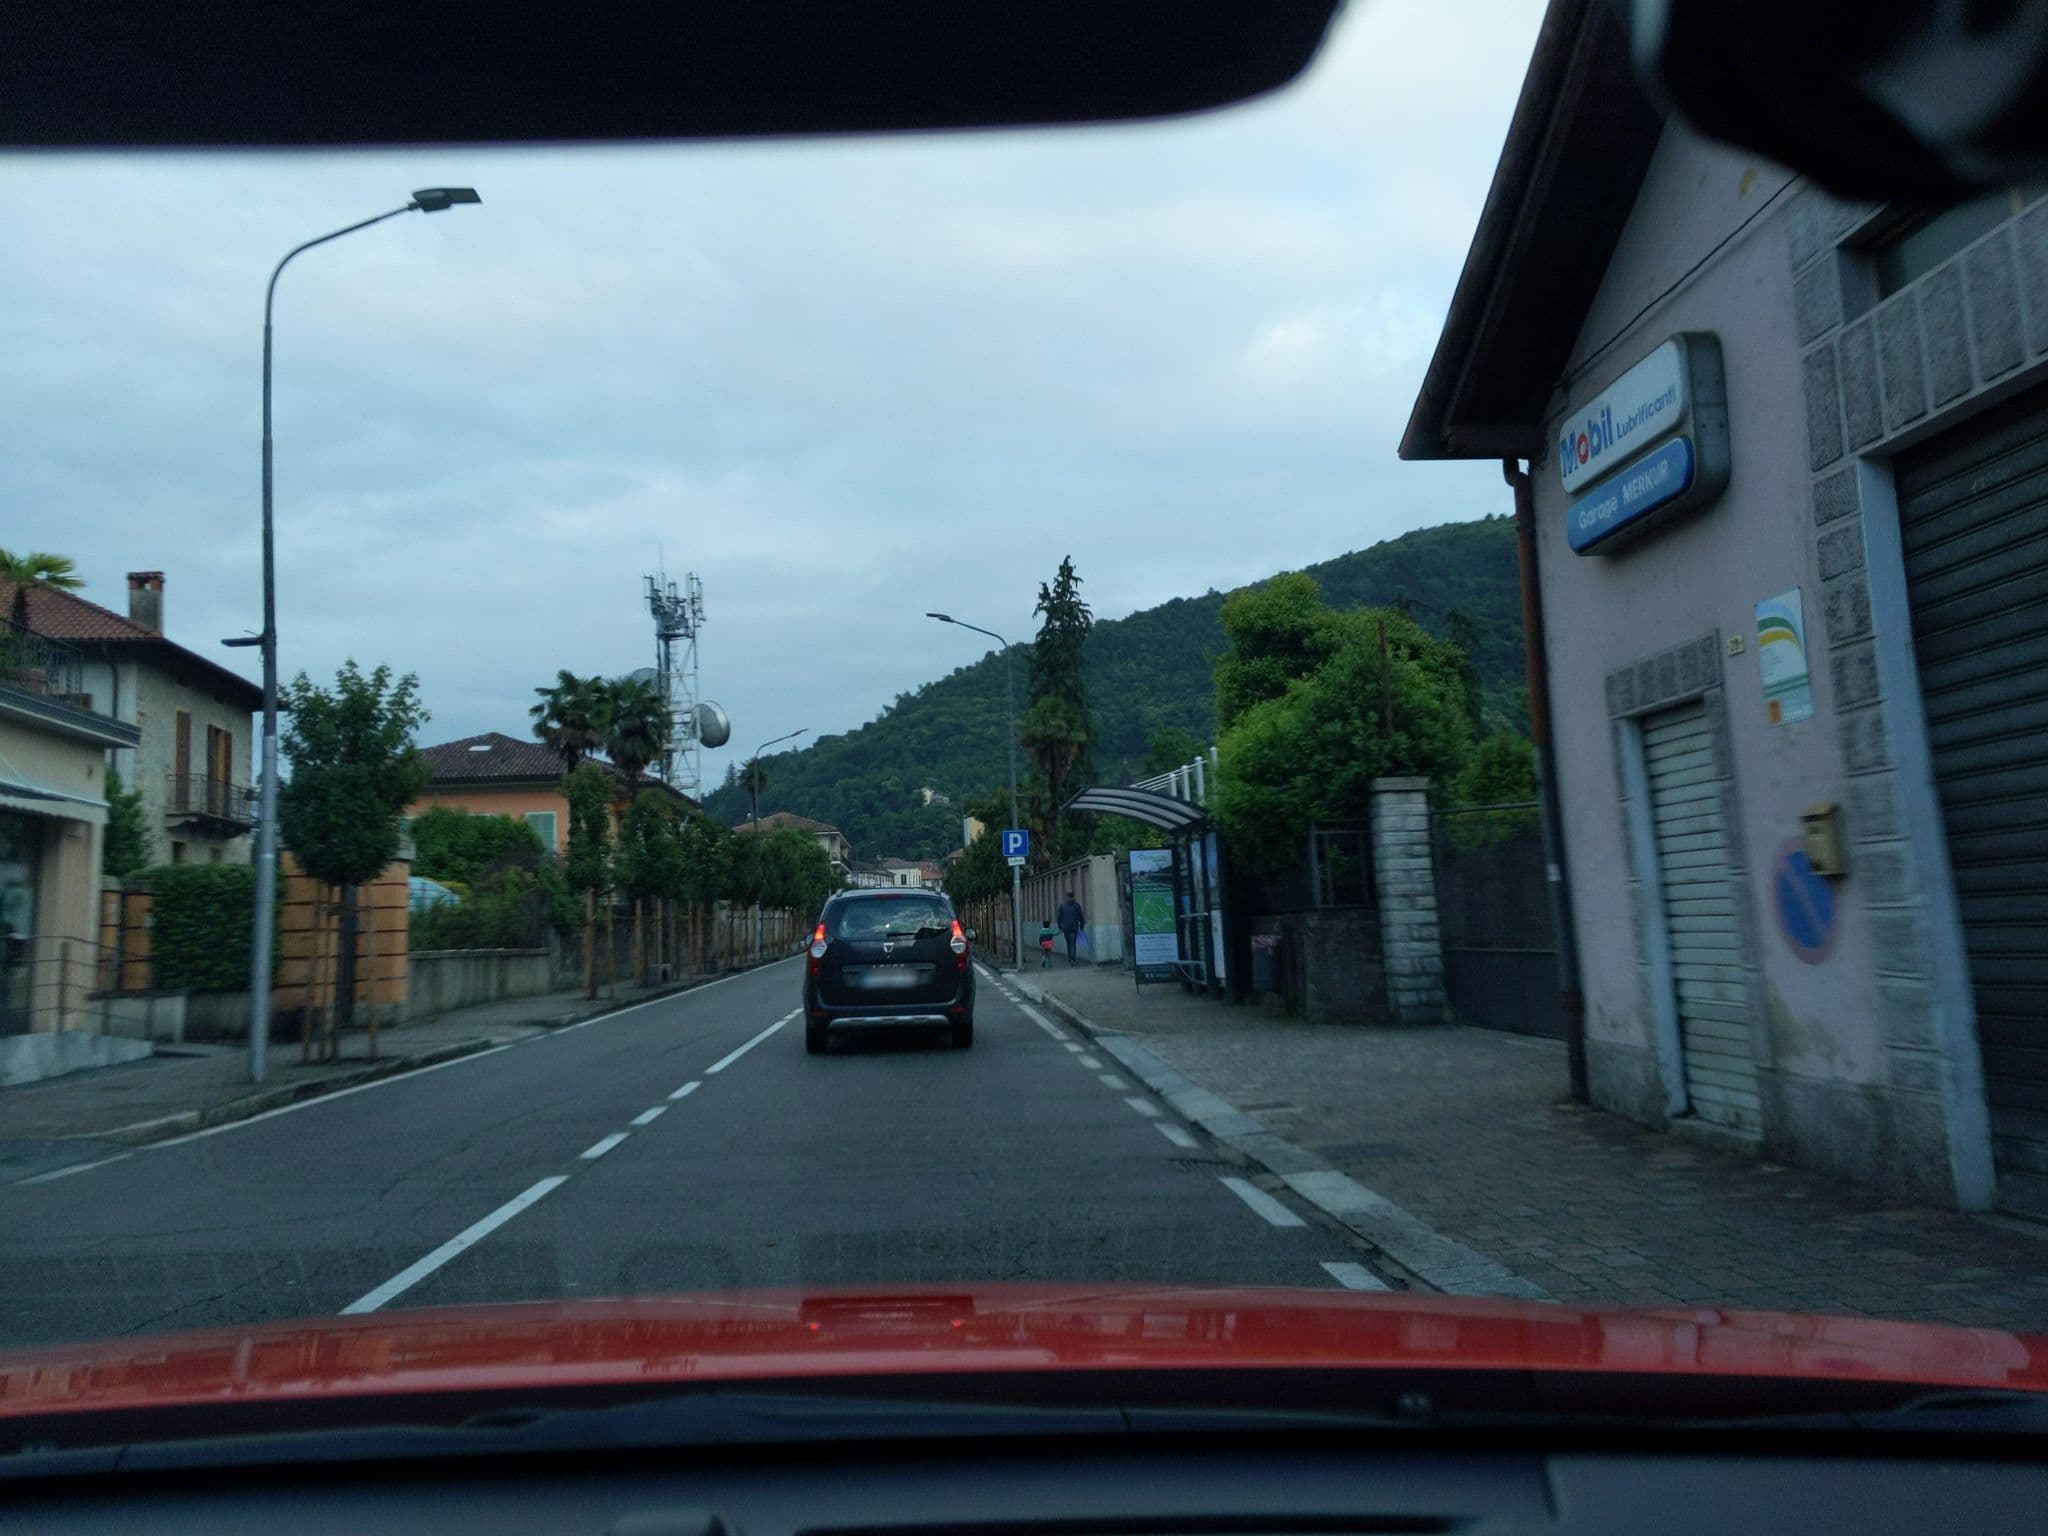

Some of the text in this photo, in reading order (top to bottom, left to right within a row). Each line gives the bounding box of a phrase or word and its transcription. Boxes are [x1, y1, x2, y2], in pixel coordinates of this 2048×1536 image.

[1560, 383, 1677, 478] Mobil Lubrificanti
[1578, 495, 1618, 530] Garage
[1008, 832, 1023, 854] P
